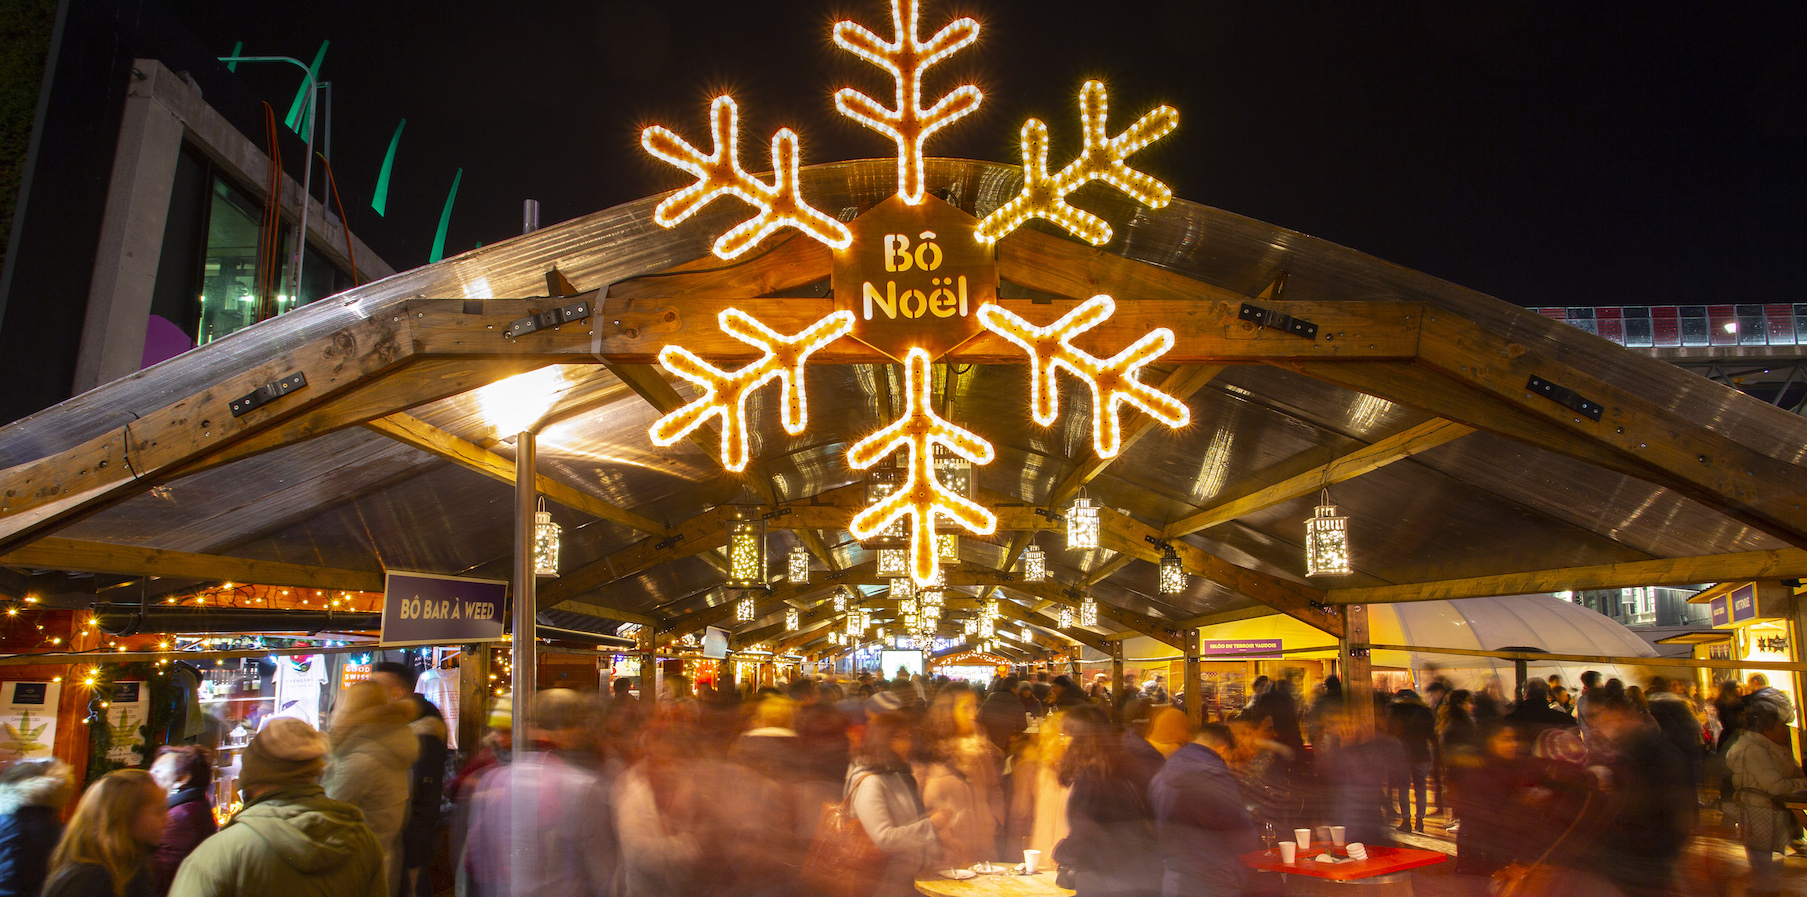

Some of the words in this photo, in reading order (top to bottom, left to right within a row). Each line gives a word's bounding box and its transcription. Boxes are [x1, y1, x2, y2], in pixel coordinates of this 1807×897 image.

[883, 230, 943, 272] Bô
[862, 275, 968, 321] Noël
[400, 594, 420, 620] BÔ
[422, 600, 449, 619] BAR
[450, 596, 461, 620] À
[464, 601, 495, 620] WEED
